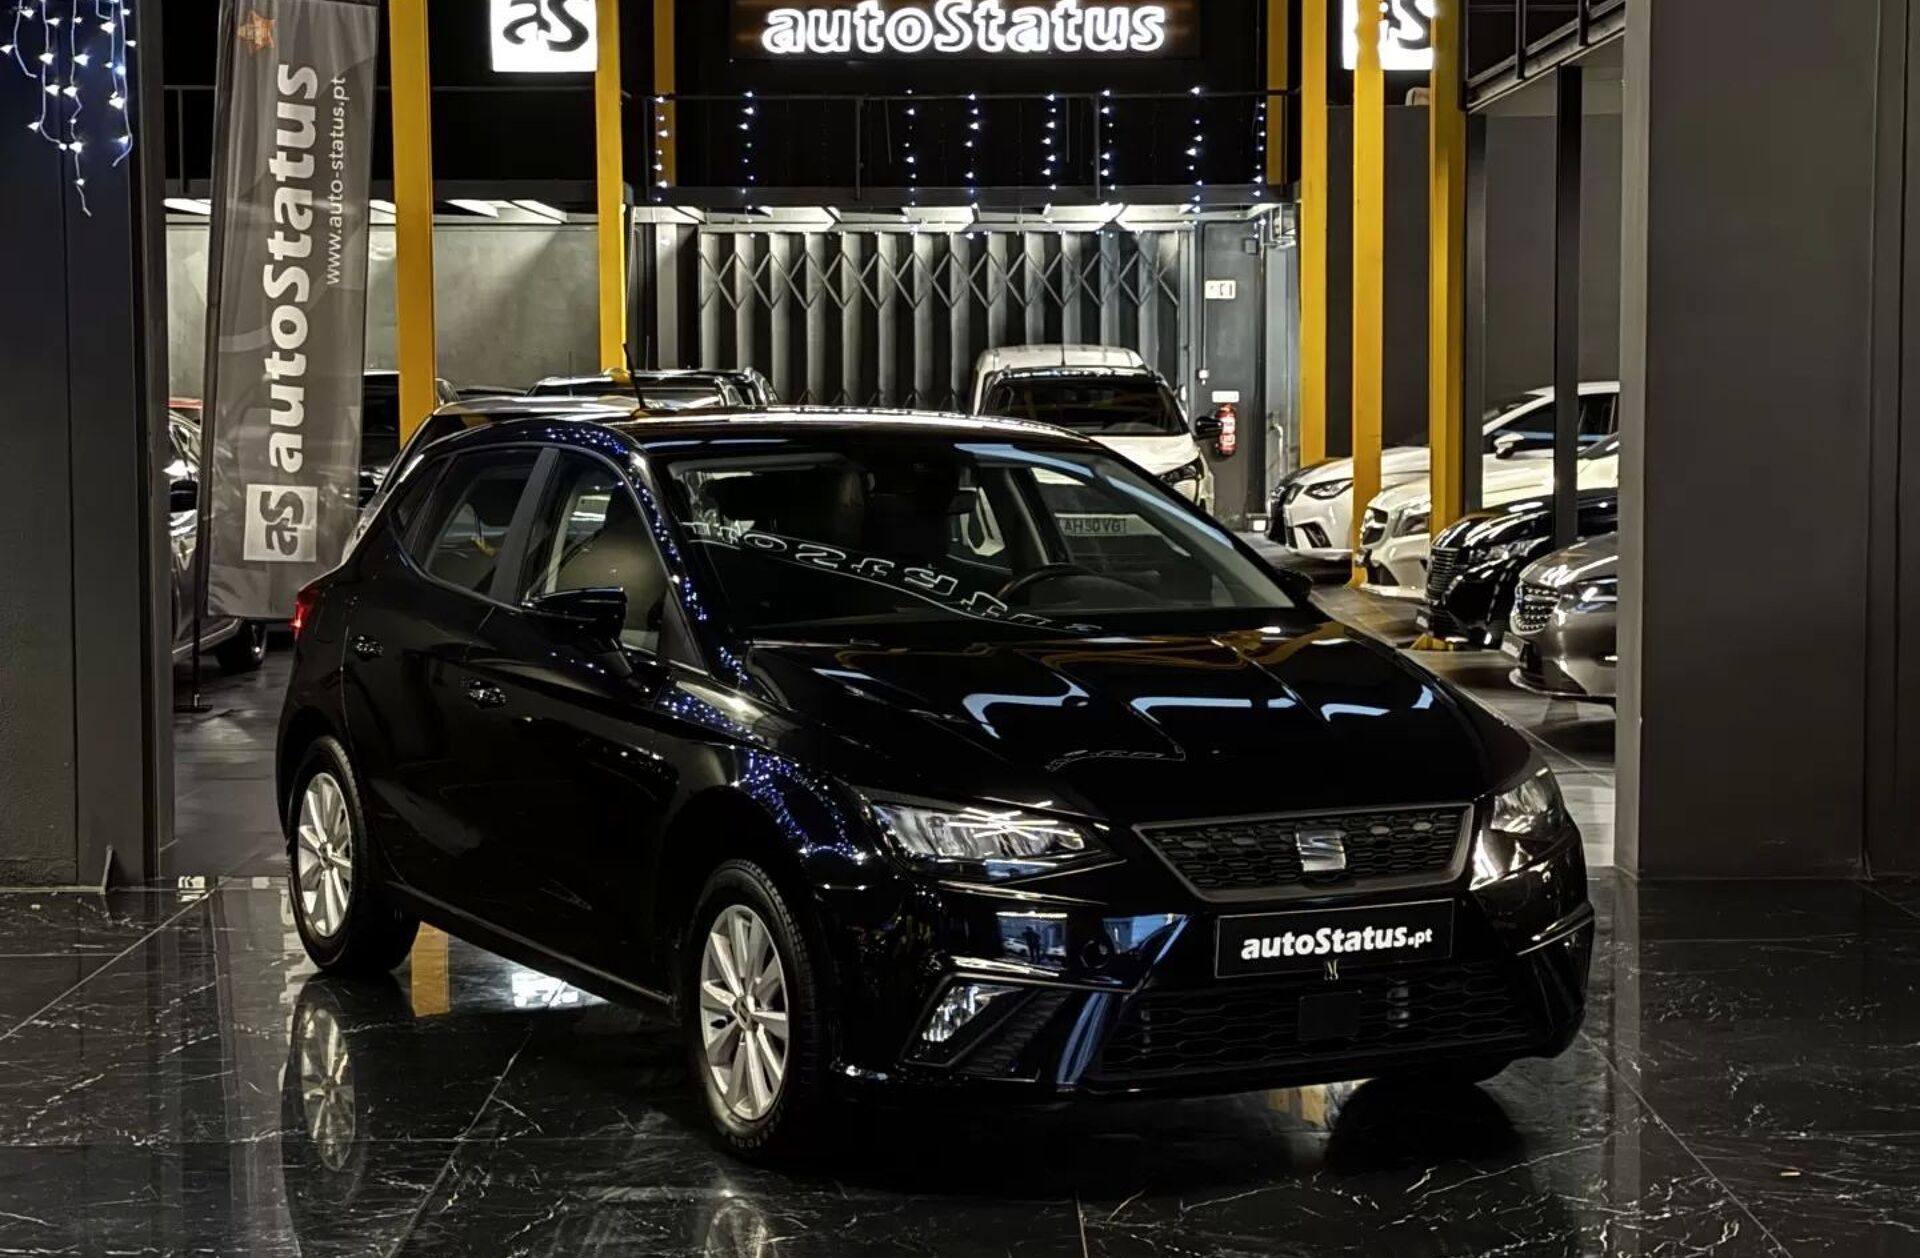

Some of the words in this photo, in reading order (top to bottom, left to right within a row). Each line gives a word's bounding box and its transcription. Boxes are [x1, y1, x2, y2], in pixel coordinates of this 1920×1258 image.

[761, 0, 1167, 54] autoStatus
[326, 77, 349, 286] www.auto-status.pt
[263, 63, 319, 474] autoStatus
[1240, 926, 1433, 960] autoStatus.pt
